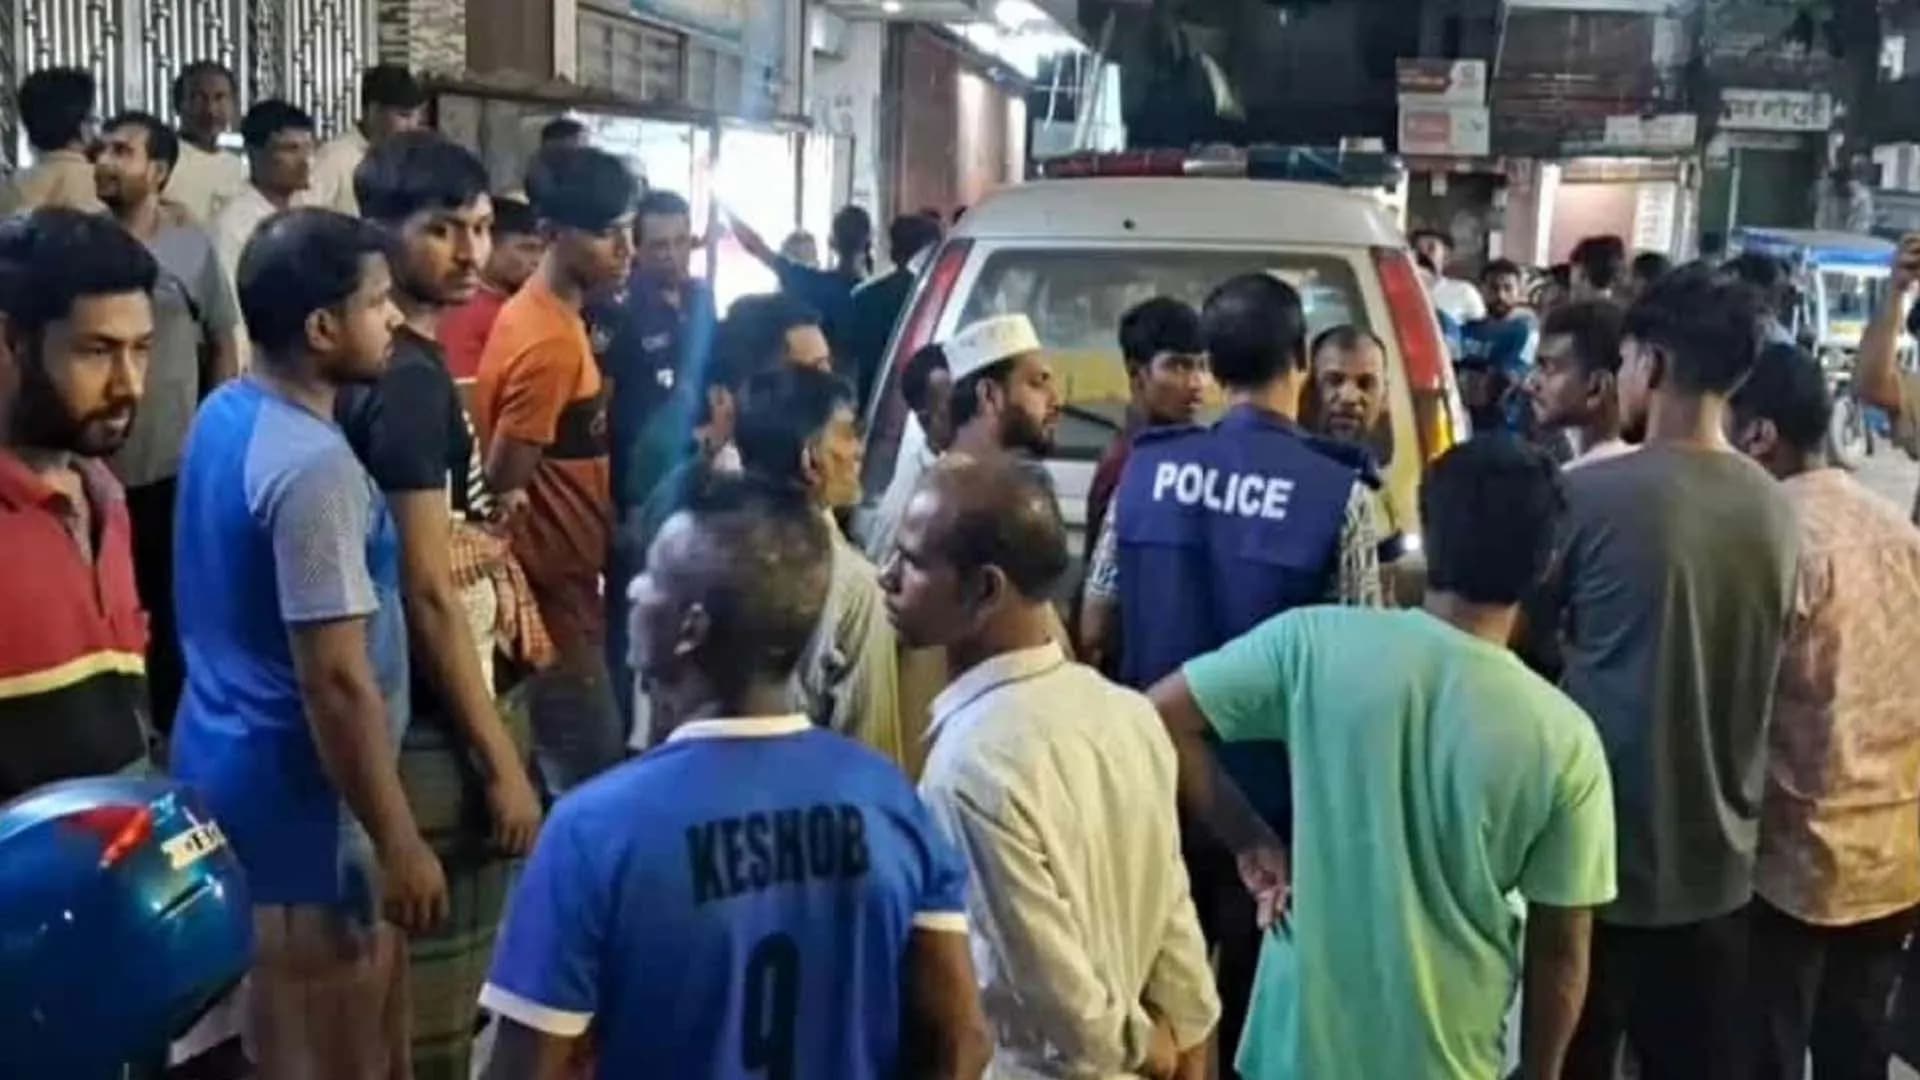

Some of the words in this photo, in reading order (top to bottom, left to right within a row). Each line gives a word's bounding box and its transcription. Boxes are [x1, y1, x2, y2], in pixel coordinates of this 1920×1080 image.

[1153, 462, 1294, 519] POLICE
[686, 804, 870, 905] KESHOB
[742, 933, 801, 1080] 9
